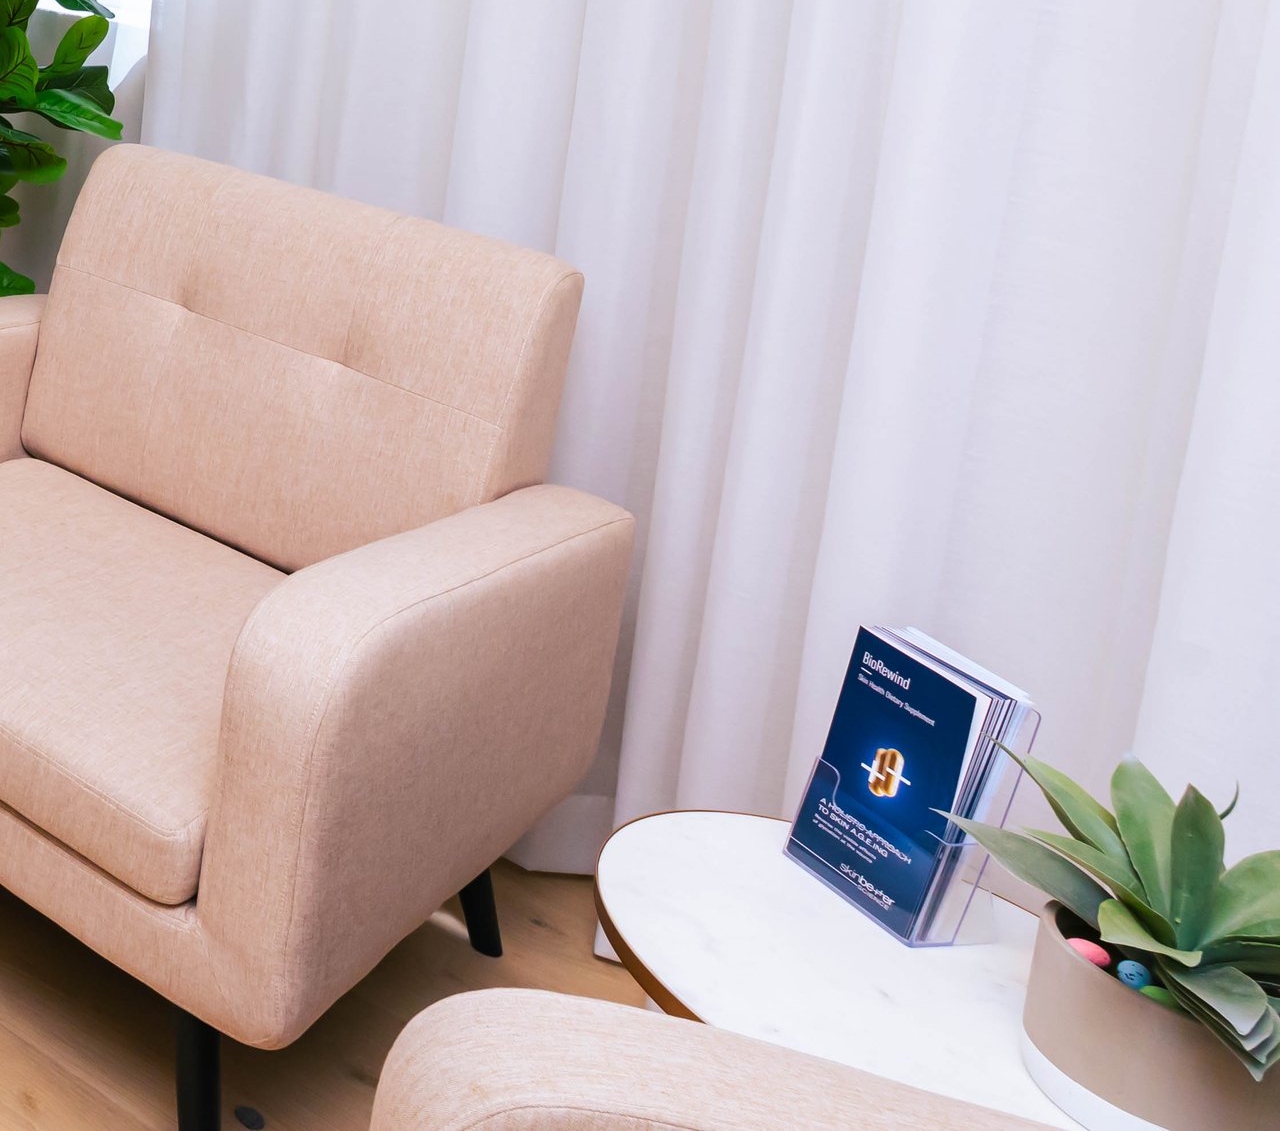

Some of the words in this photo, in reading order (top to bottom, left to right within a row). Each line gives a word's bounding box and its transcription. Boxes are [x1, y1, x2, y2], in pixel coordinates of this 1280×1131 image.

[862, 651, 911, 690] BioRewind
[819, 804, 829, 815] TO
[830, 813, 850, 830] SKIN
[828, 802, 866, 831] HOLISTIC
[866, 830, 912, 864] APPROACH
[840, 863, 896, 906] skinbetter
[857, 885, 890, 910] SCIENCE
